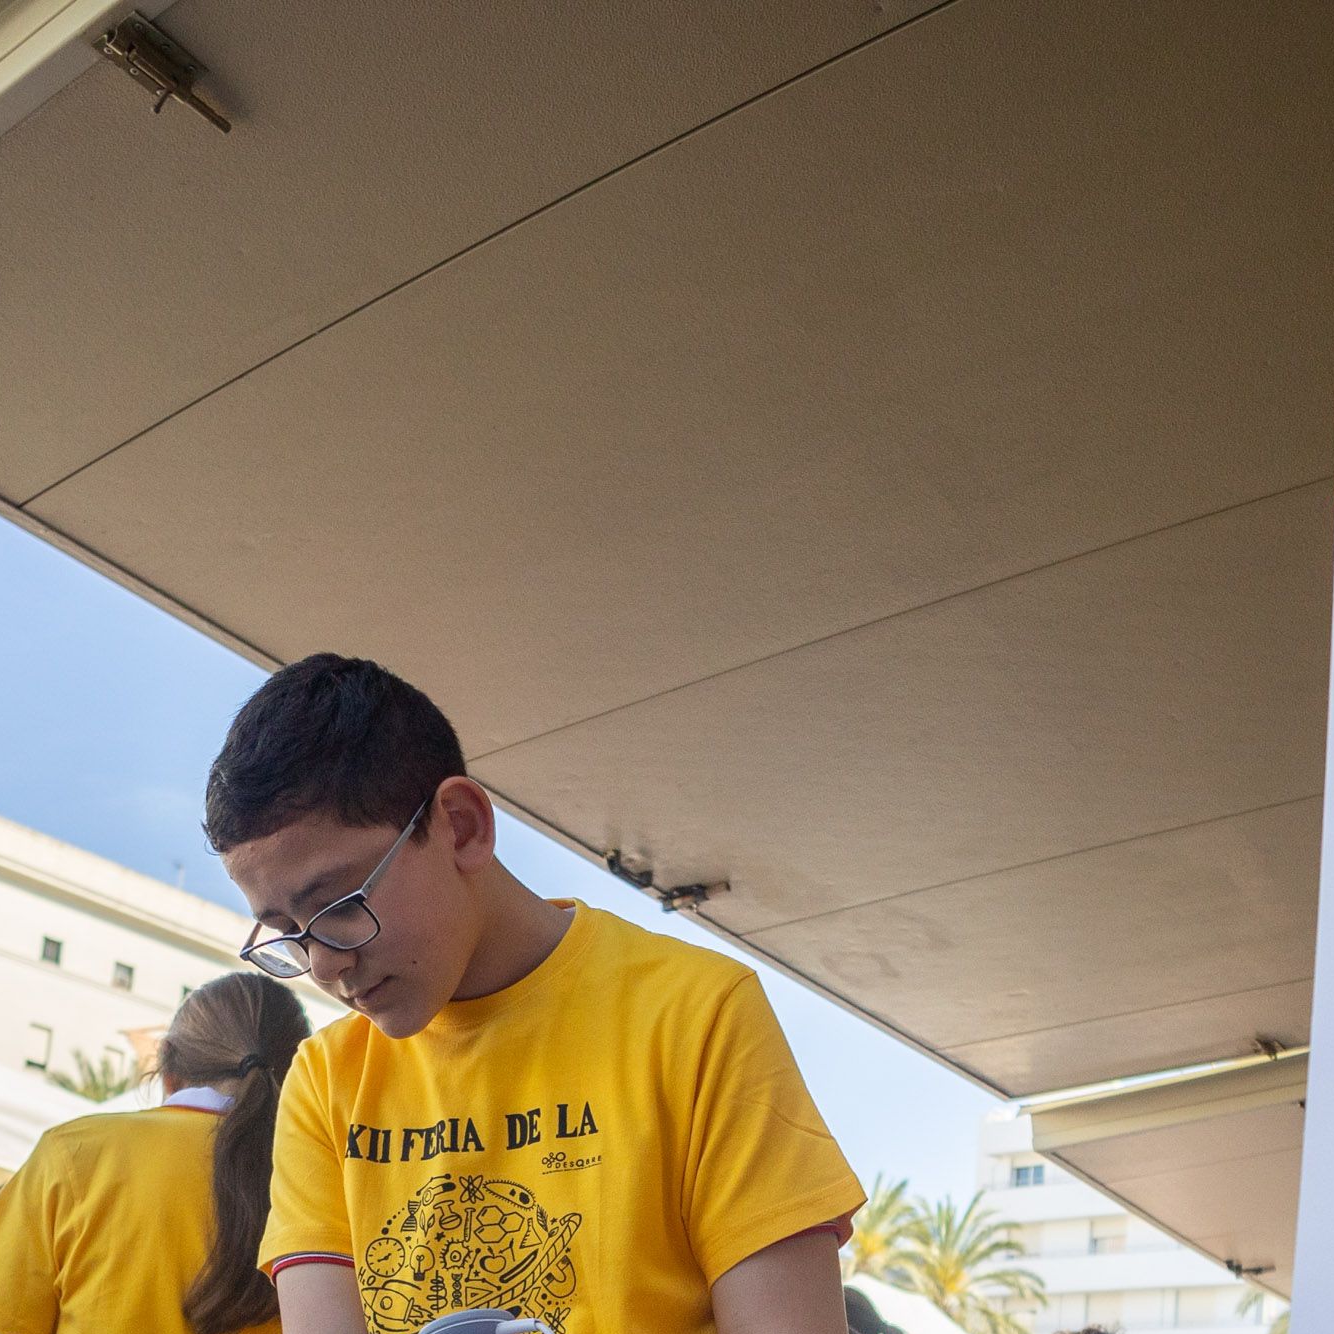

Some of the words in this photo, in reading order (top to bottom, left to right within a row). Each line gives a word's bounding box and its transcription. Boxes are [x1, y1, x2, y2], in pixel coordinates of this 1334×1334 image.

[400, 1117, 485, 1162] FERIA
[505, 1107, 542, 1151] DE
[555, 1101, 599, 1139] LA
